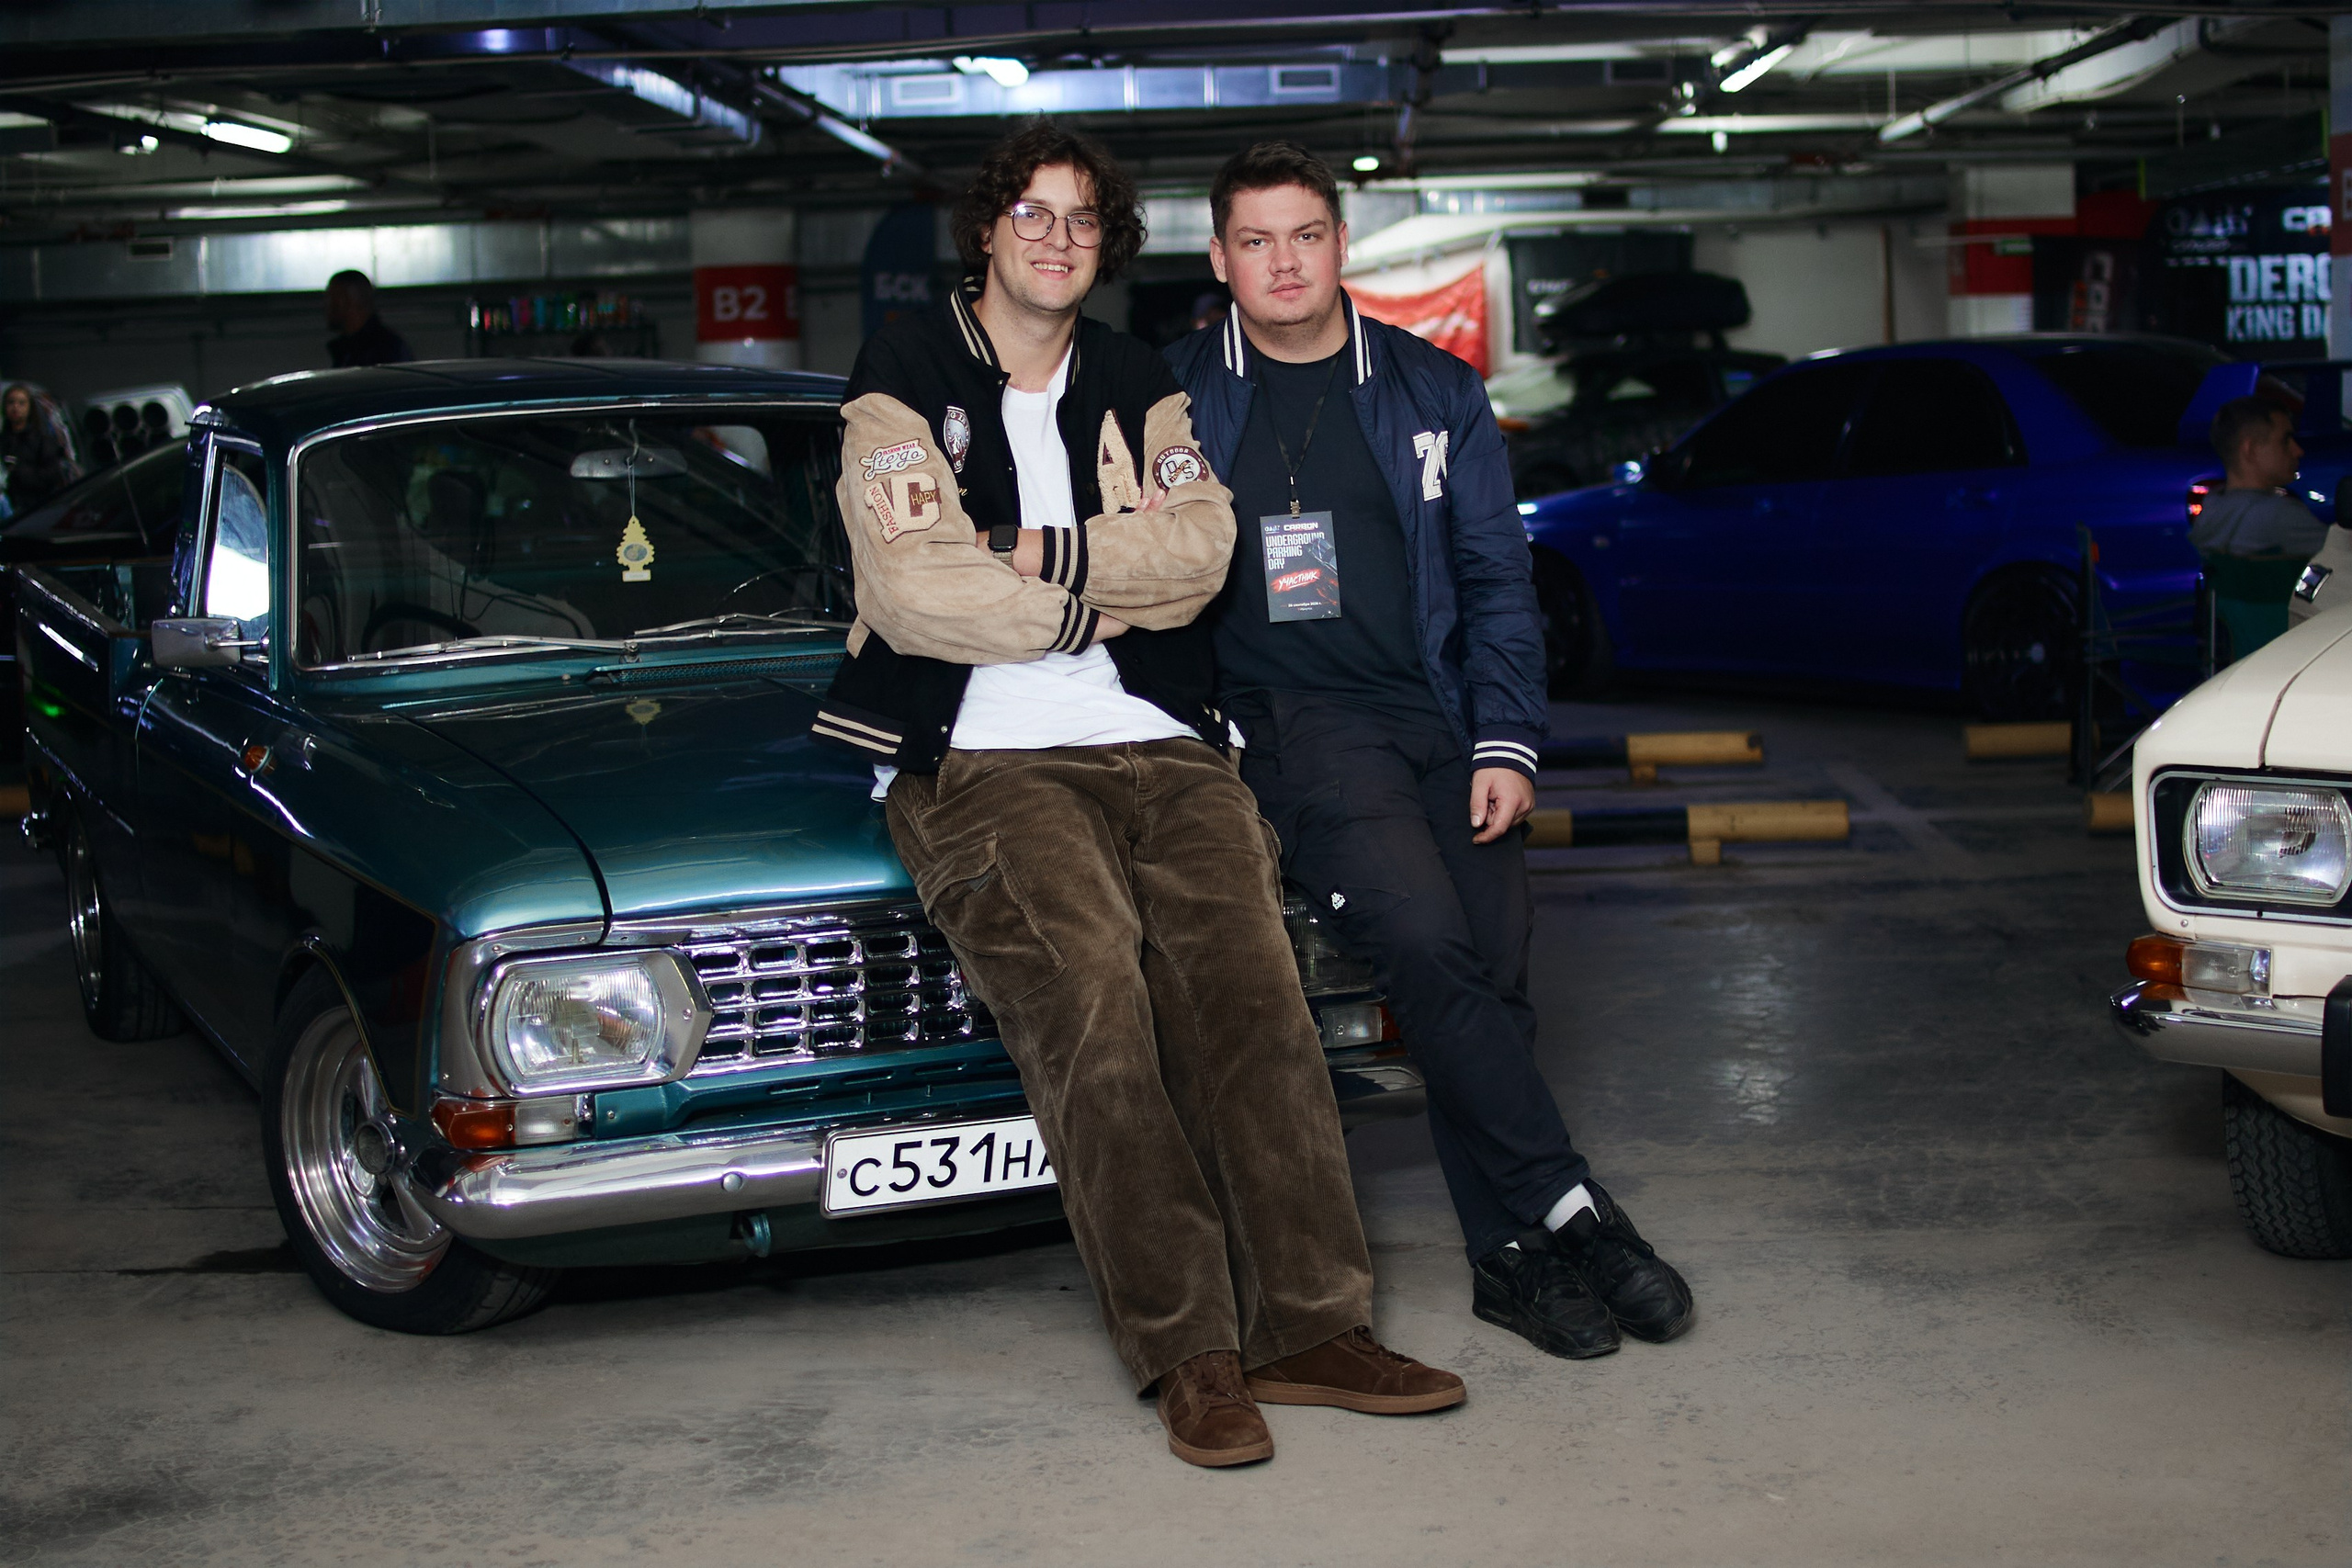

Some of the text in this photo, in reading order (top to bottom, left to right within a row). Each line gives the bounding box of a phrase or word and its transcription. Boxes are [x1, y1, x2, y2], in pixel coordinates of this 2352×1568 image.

[712, 286, 768, 321] B2
[2226, 304, 2326, 341] KING D
[1156, 447, 1190, 465] OUTDOOR
[910, 491, 937, 506] HAPY
[869, 486, 900, 535] FASHION
[1283, 522, 1318, 532] CARBON
[1267, 545, 1303, 558] PARKING
[1268, 558, 1285, 570] DAY
[1278, 571, 1319, 592] УЧАСТНИК
